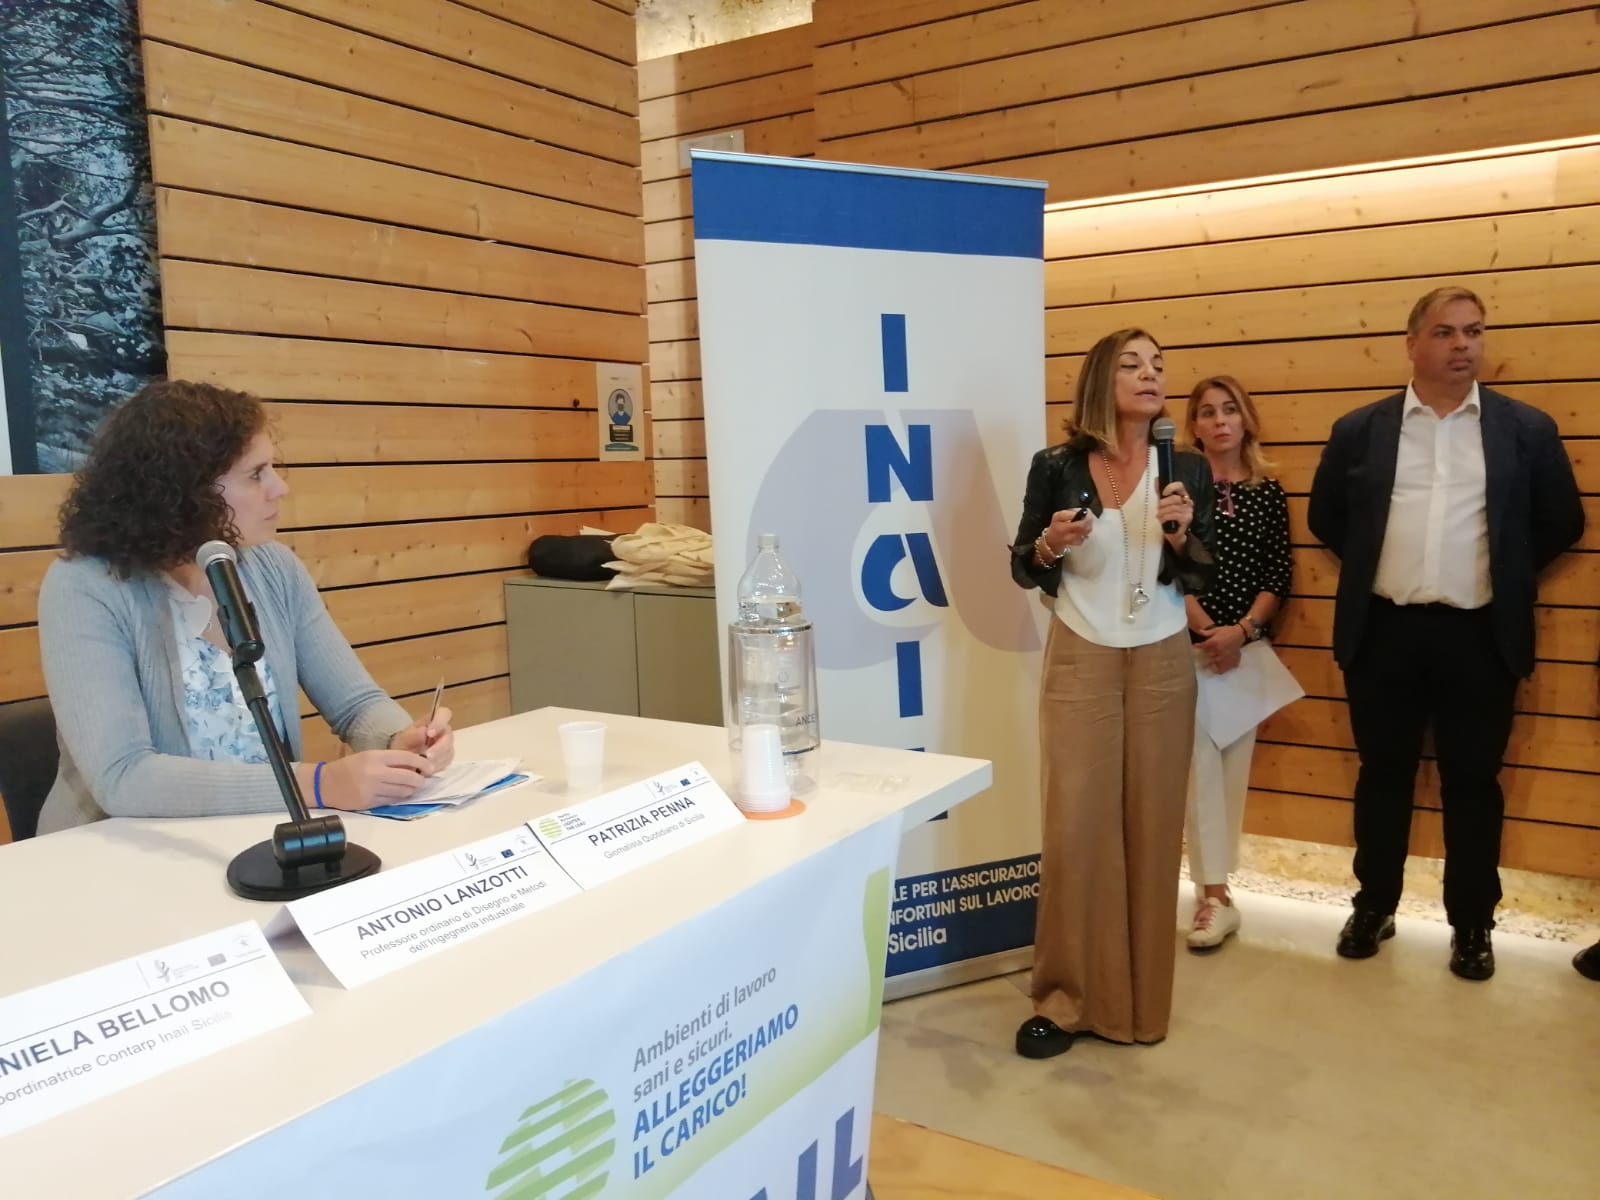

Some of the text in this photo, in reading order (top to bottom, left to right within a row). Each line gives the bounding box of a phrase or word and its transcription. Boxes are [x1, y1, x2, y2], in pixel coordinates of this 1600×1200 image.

[860, 312, 950, 770] INAI
[587, 796, 696, 847] PATRIZIA PENNA
[603, 839, 643, 859] Giornalista
[641, 824, 679, 843] Quotidiano
[355, 864, 529, 941] ANTONIO LANZOTTI
[359, 929, 420, 960] Professore
[419, 913, 463, 937] ordinario
[462, 907, 473, 920] di
[471, 894, 511, 915] Disegno
[516, 879, 548, 897] Metodi
[408, 901, 526, 955] dell'Ingegneria Industriale
[911, 880, 938, 899] PER
[959, 893, 984, 912] SUL
[888, 925, 948, 955] Sicilia
[0, 980, 231, 1079] NIELA BELLOMO
[95, 1037, 157, 1067] Contarp
[157, 1024, 191, 1044] Inail
[190, 1010, 234, 1031] Sicilia
[632, 966, 777, 1073] Ambienti di lavoro
[632, 1020, 733, 1104] sani e sicuri.
[632, 1003, 800, 1143] ALLEGGERIAMO
[633, 1072, 747, 1181] IL CARICO!
